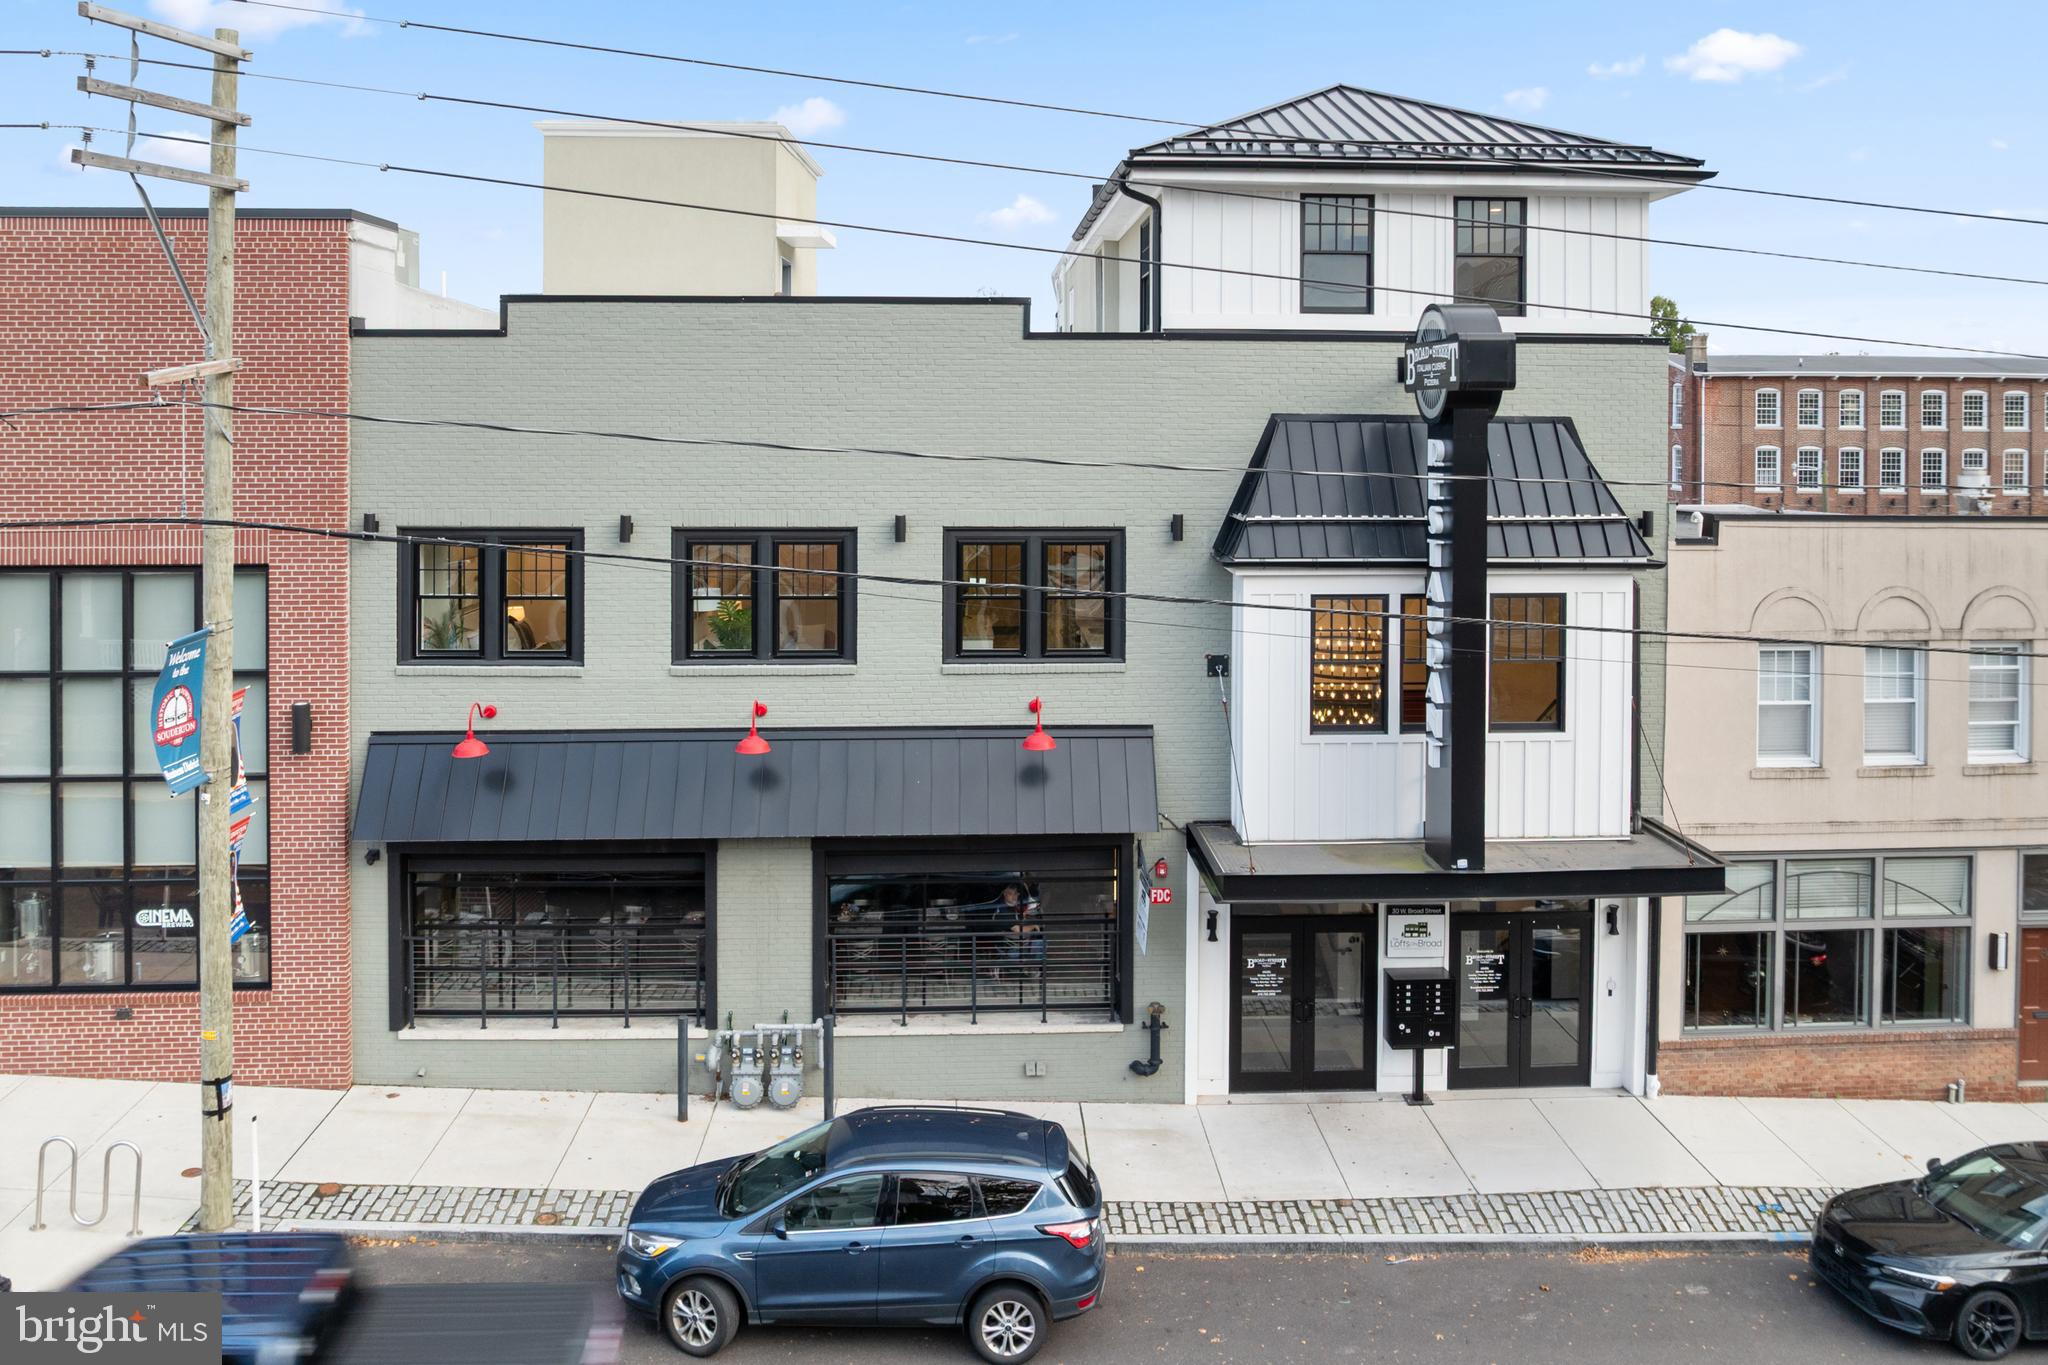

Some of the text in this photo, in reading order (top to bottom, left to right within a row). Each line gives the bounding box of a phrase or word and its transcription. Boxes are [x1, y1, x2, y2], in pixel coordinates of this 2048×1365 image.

[1426, 439, 1448, 768] RESTAURANT
[169, 648, 200, 666] Welcome
[172, 664, 190, 679] to the
[157, 721, 196, 742] SOUDERTON
[1151, 889, 1170, 902] FDC
[136, 908, 193, 926] CINEMA
[1418, 939, 1442, 947] Broad
